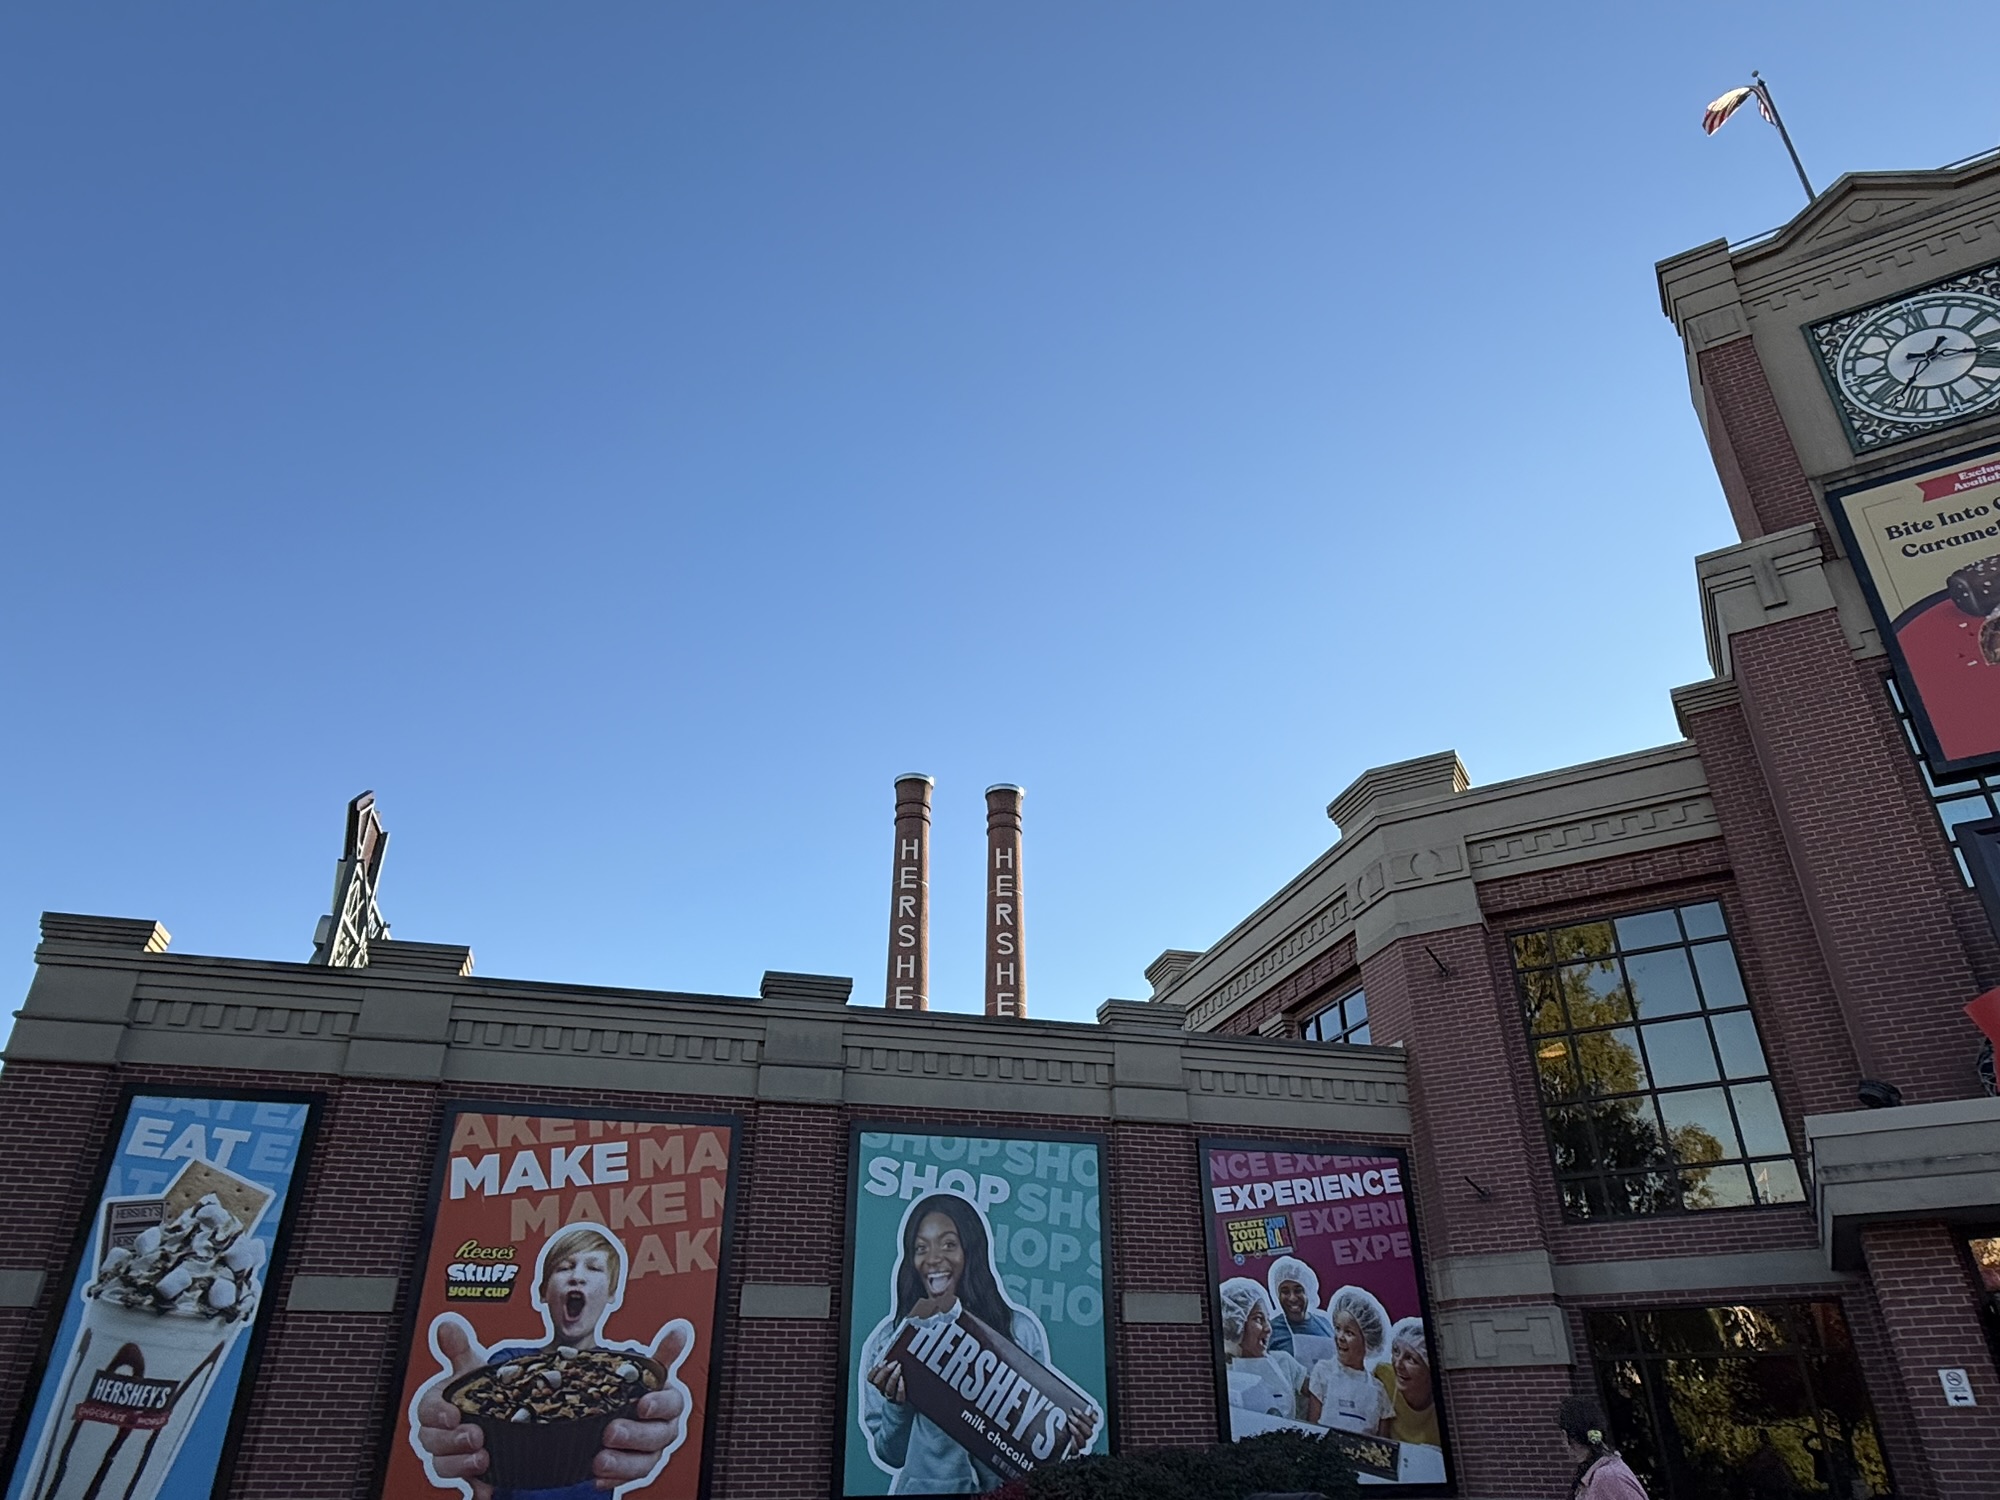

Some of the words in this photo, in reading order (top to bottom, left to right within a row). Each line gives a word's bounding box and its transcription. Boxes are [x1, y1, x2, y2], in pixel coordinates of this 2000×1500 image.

[1885, 520, 1935, 540] Bite
[1936, 505, 1989, 526] Into
[895, 839, 919, 1010] HERSHE
[996, 848, 1015, 1016] HERSHE
[125, 1117, 251, 1168] EAT
[451, 1141, 629, 1200] MAKE
[640, 1131, 728, 1179] MA
[864, 1156, 1011, 1213] SHOP
[1209, 1153, 1269, 1181] NCE
[511, 1181, 688, 1242] MAKE
[1212, 1168, 1403, 1213] EXPERIENCE
[1228, 1219, 1264, 1231] CREATE
[1230, 1227, 1266, 1242] YOUR
[1233, 1238, 1268, 1253] OWN
[1266, 1227, 1291, 1248] BAR
[454, 1239, 517, 1260] Reese's
[92, 1378, 171, 1409] HERSHEY'S
[907, 1322, 1068, 1461] HERSHEY'S
[961, 1409, 987, 1434] milk
[986, 1430, 1038, 1472] chocolat
